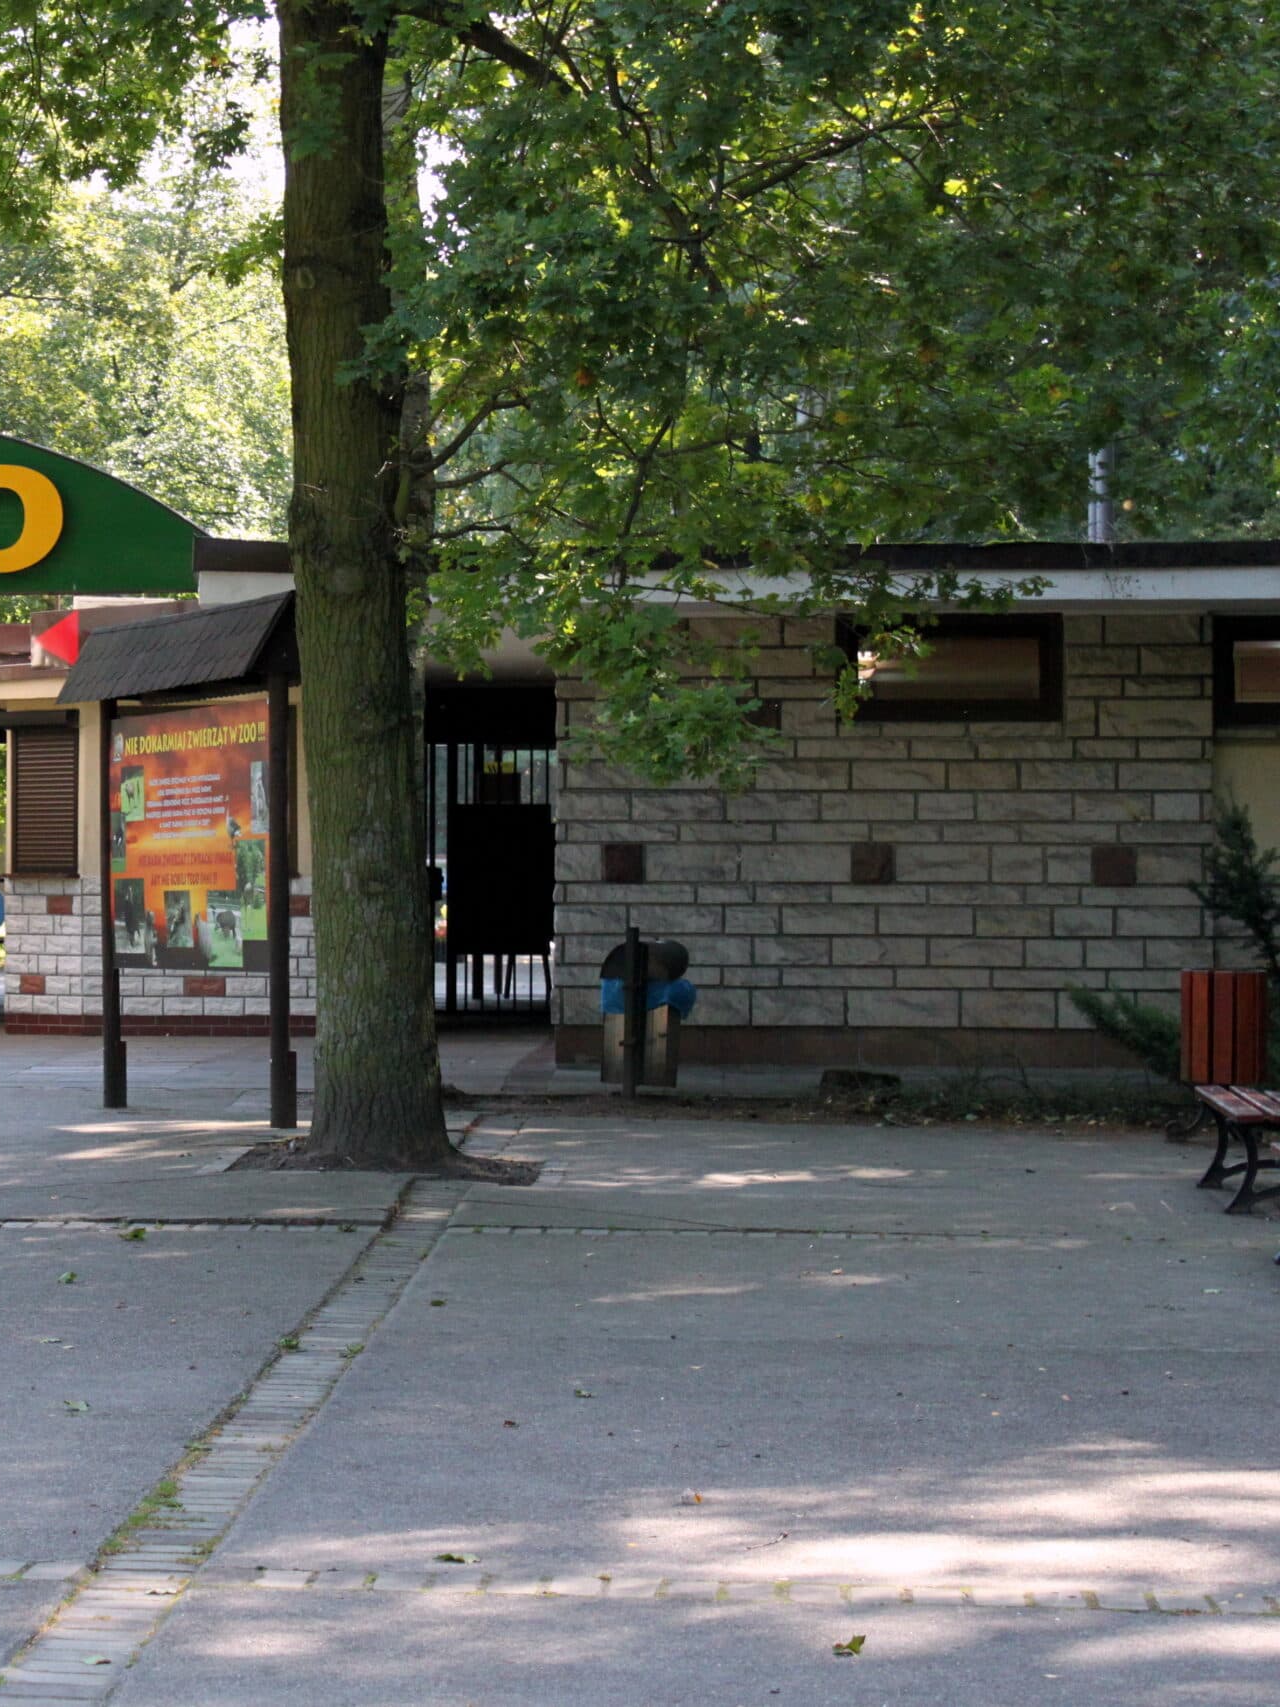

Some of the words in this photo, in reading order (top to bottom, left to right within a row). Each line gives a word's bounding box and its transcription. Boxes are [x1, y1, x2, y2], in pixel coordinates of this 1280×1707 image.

[125, 736, 138, 756] NIE
[139, 731, 186, 755] DOKARMIAJ
[238, 722, 256, 743] ZOO
